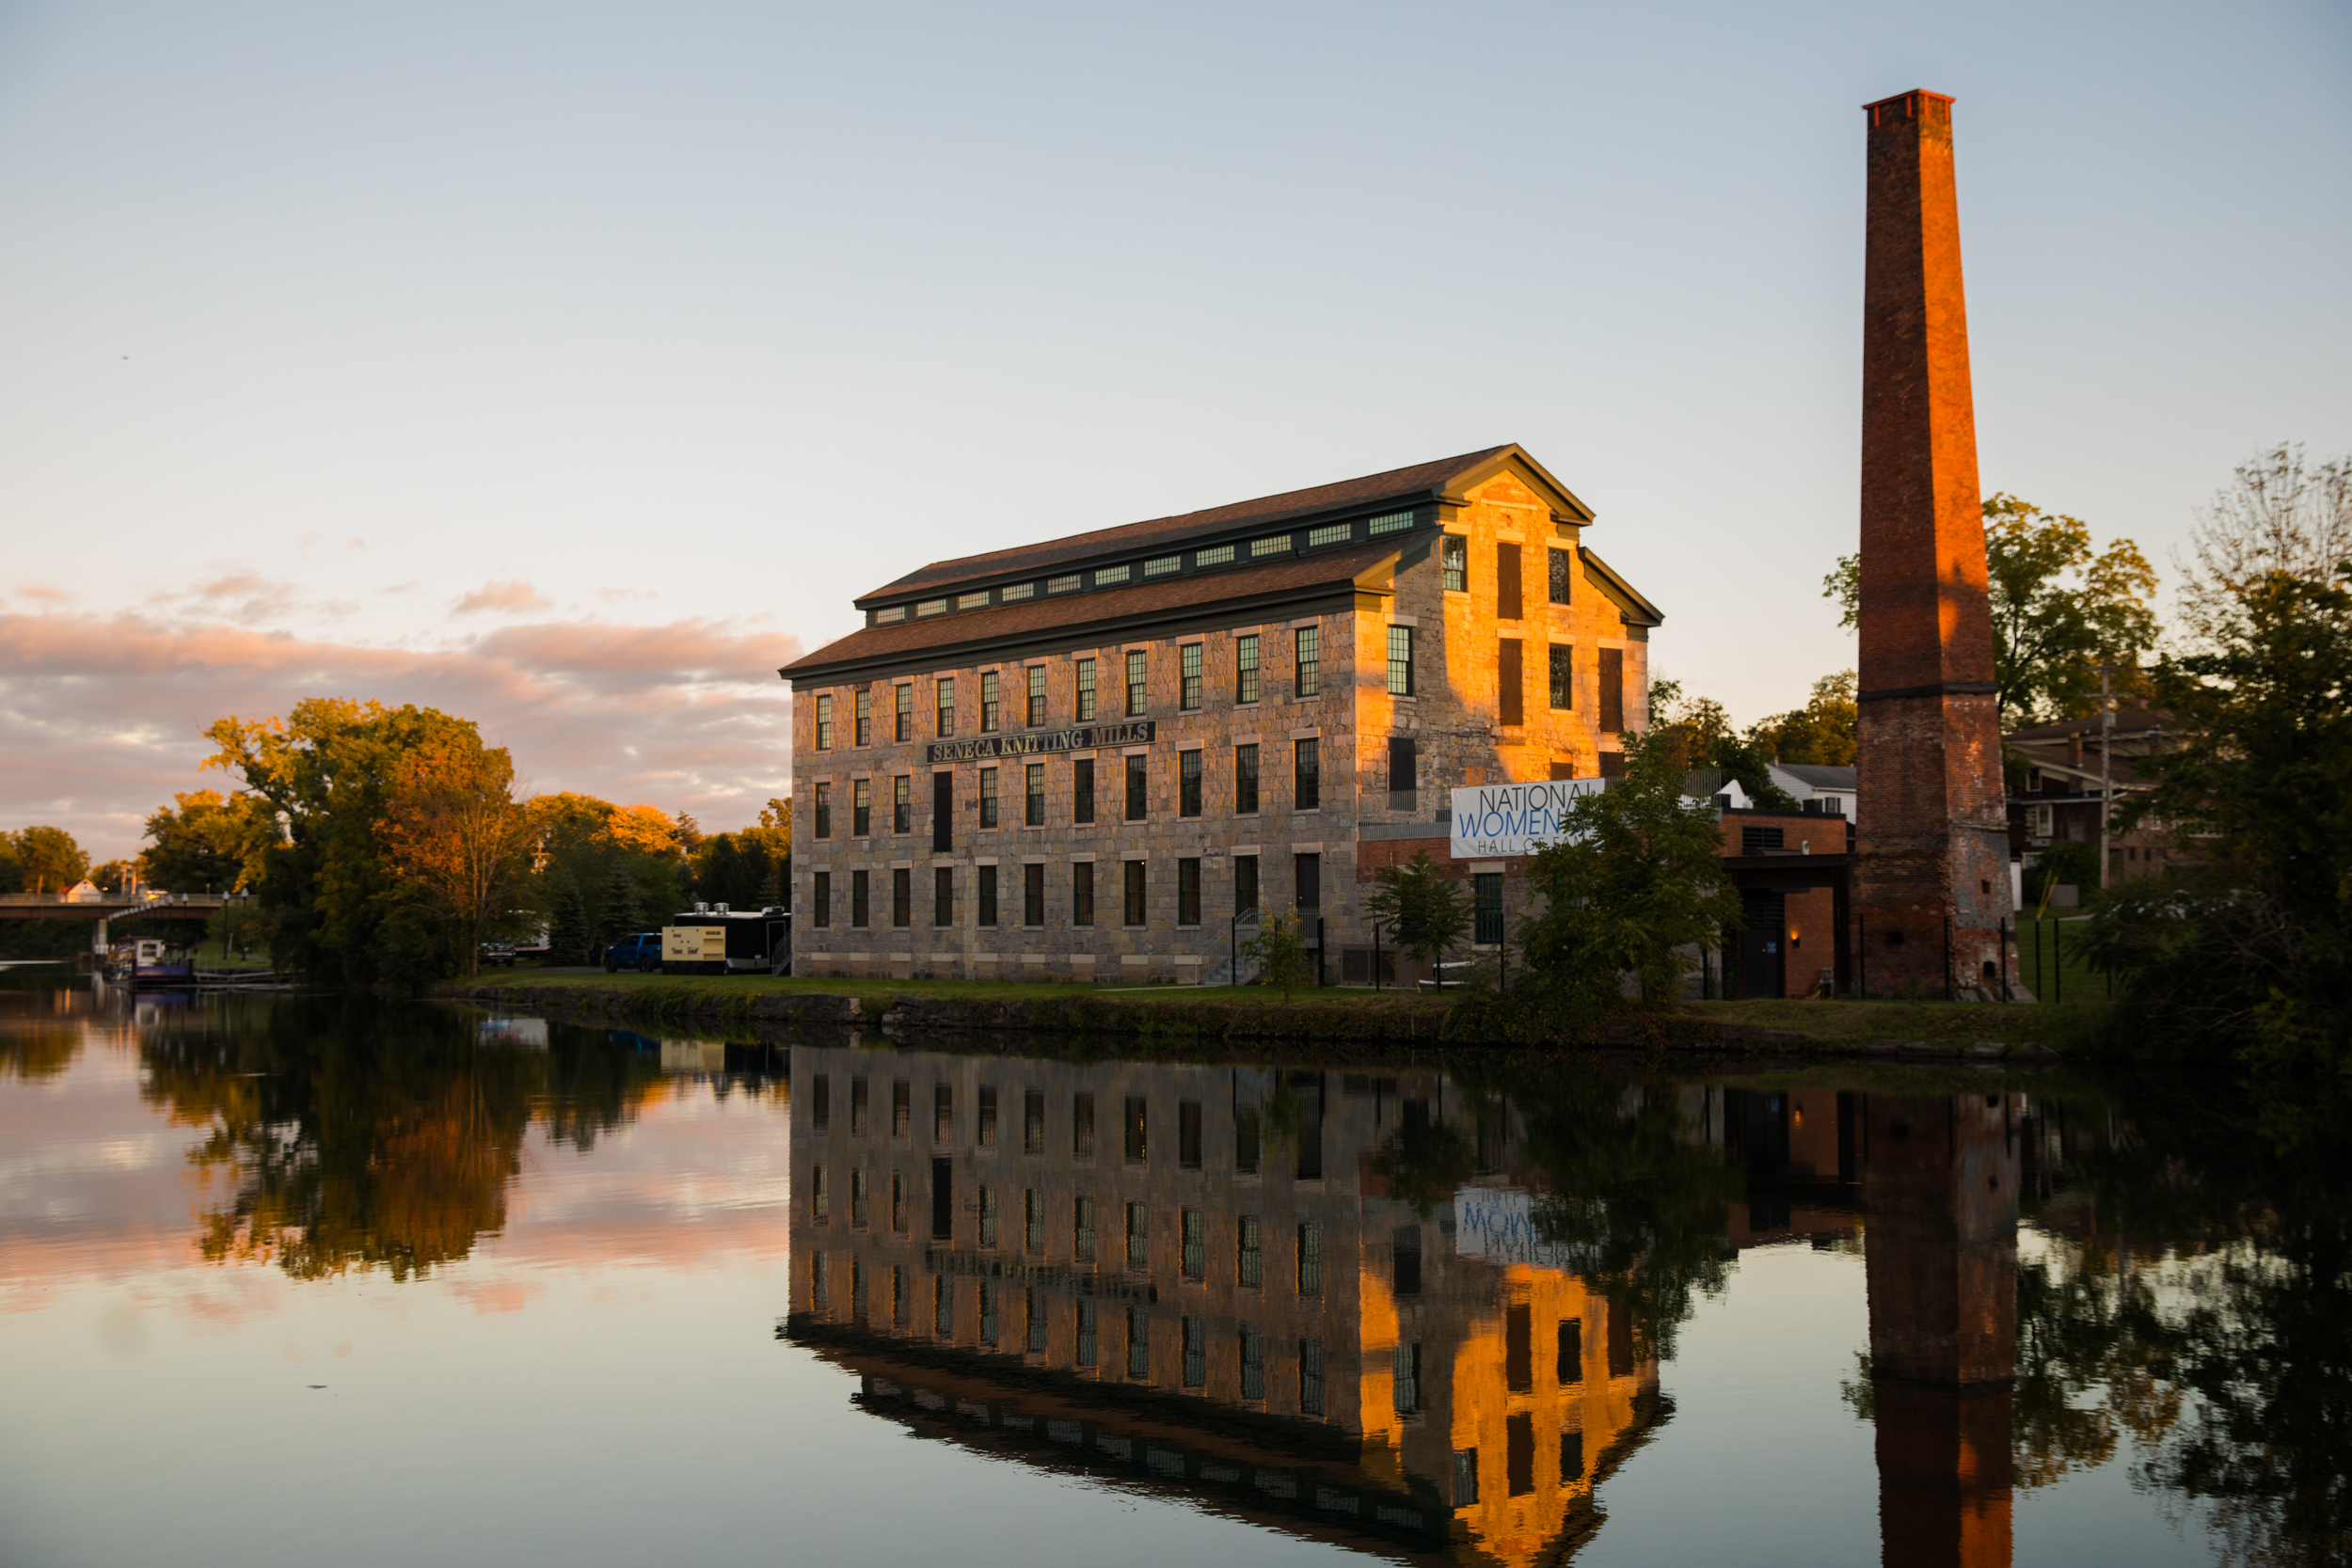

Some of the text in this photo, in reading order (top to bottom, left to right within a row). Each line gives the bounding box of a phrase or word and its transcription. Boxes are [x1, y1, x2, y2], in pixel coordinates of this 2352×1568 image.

[933, 723, 1148, 762] SENECA KNITTING MILLS
[1478, 838, 1515, 853] HALL
